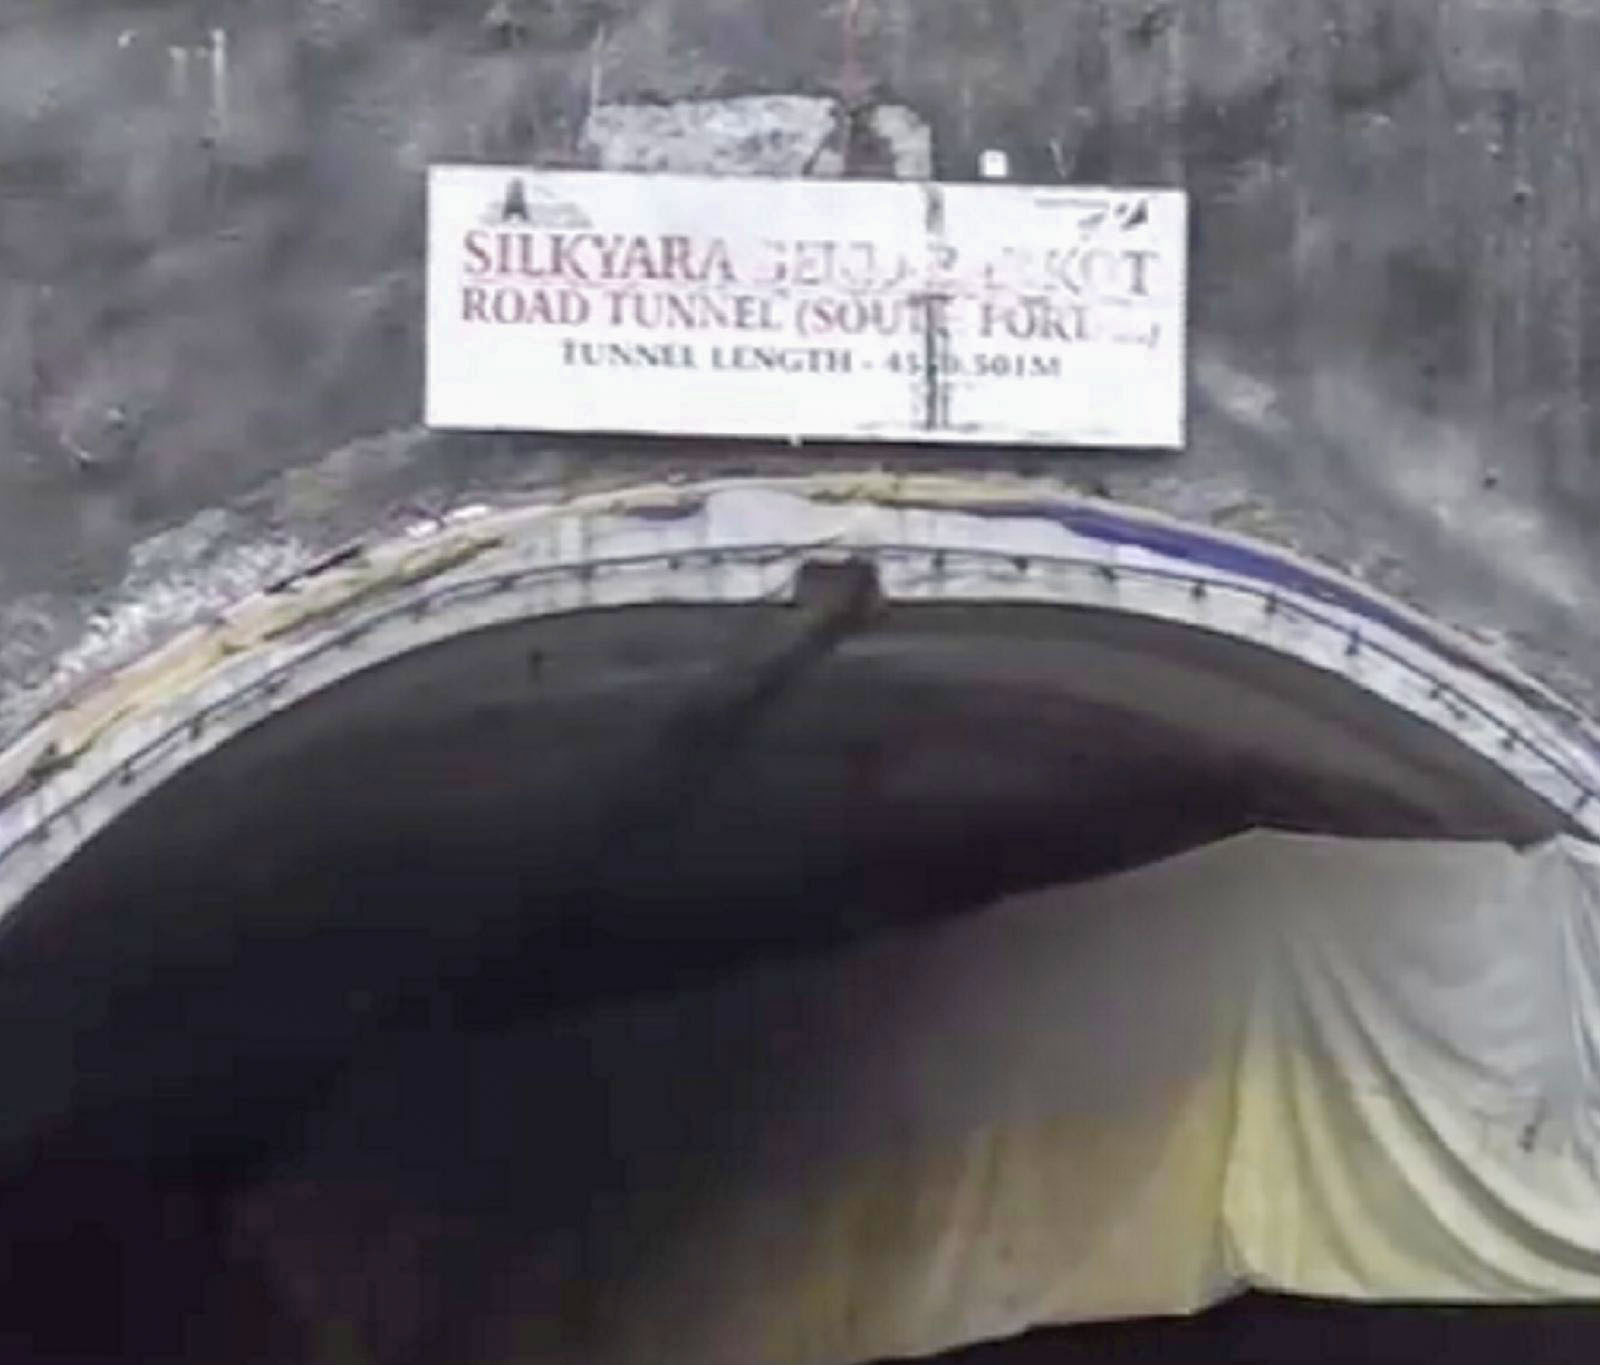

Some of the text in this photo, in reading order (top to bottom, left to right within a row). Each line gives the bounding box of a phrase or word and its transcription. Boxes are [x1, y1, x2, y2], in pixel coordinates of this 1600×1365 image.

[462, 229, 737, 283] SILKYARA
[461, 285, 591, 326] ROAD
[606, 291, 782, 331] TUNNEL
[562, 338, 698, 368] TUNNEL
[711, 344, 852, 374] LENGTH
